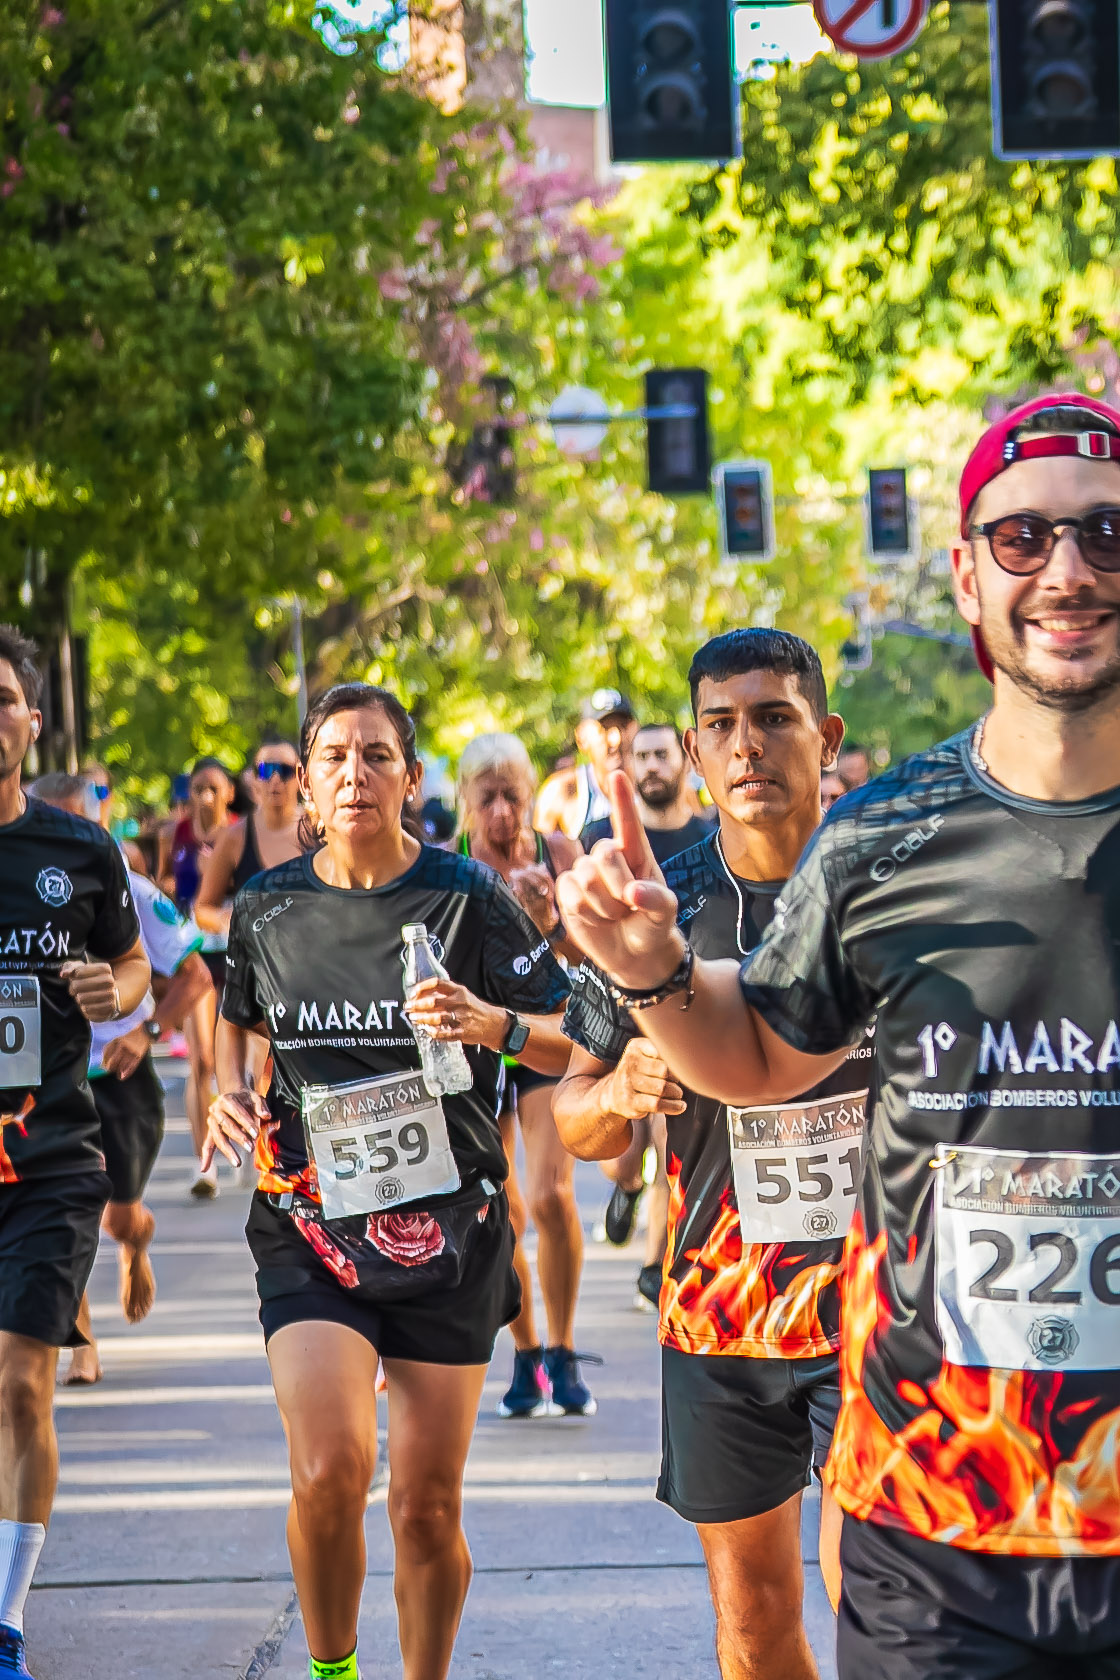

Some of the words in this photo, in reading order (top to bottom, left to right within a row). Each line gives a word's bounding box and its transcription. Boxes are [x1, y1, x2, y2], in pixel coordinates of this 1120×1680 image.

[0, 922, 70, 957] ATÓN
[0, 1016, 26, 1055] 0
[916, 1021, 958, 1078] 1º
[342, 1083, 422, 1119] MARATÓN
[907, 1090, 989, 1111] ASOCIACIÓN
[989, 1088, 1078, 1107] BOMBEROS
[750, 1118, 767, 1139] 1º
[773, 1103, 866, 1137] MARATÓN
[329, 1122, 430, 1181] 559
[754, 1147, 862, 1205] 551
[812, 1217, 827, 1230] 27
